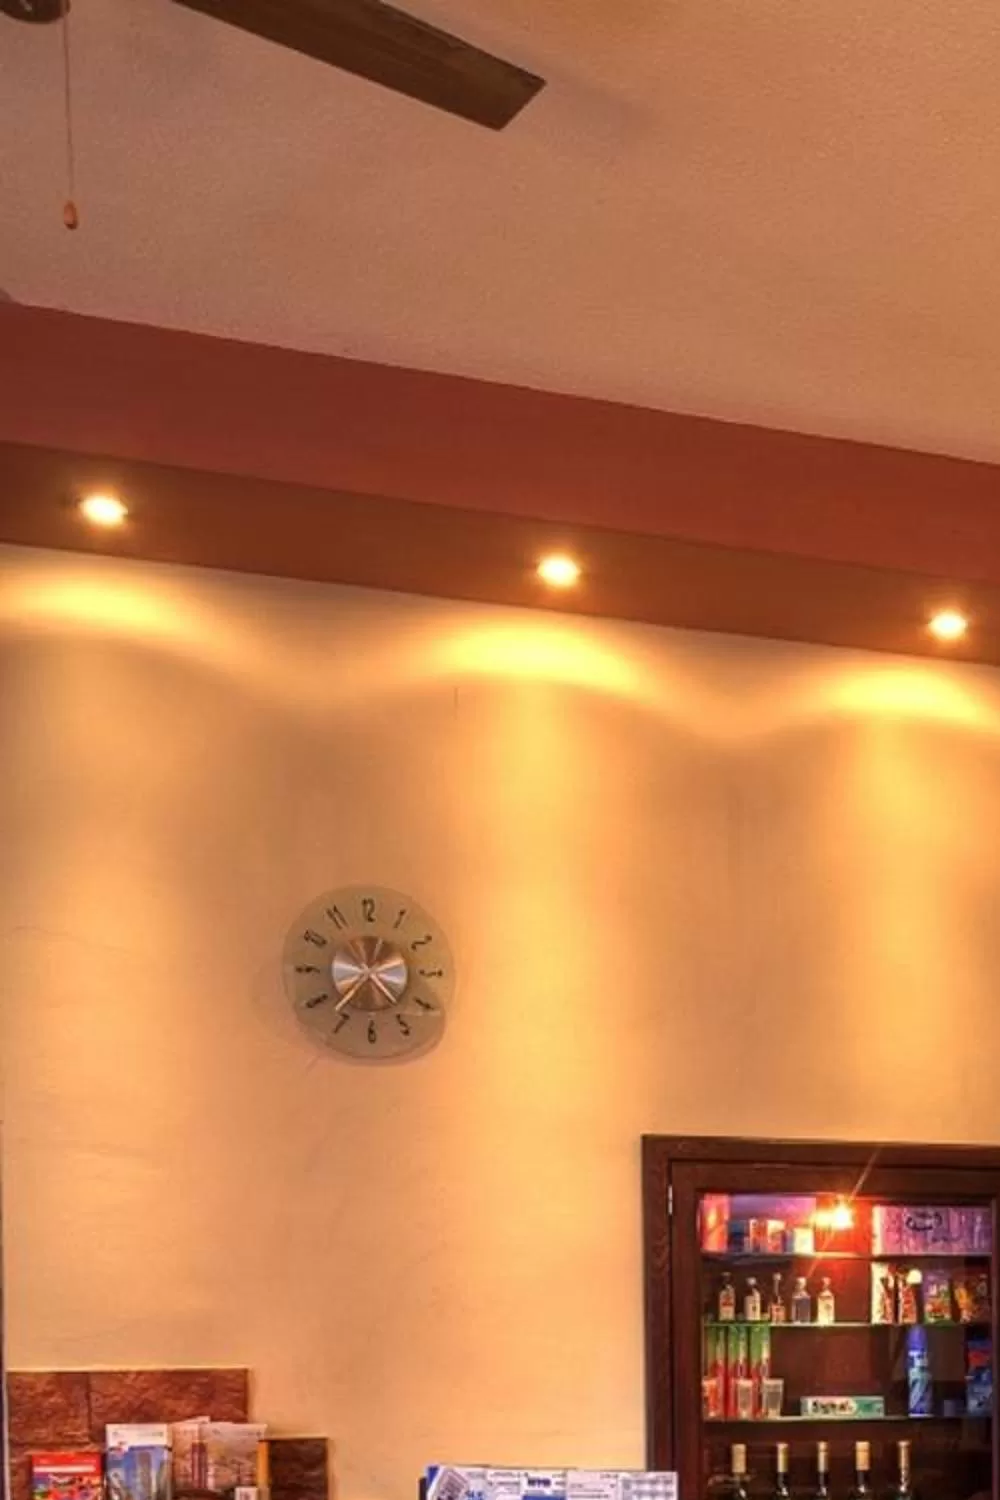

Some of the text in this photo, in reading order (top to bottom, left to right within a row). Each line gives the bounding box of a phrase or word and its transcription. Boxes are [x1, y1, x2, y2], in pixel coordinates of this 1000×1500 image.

[326, 904, 349, 930] 11
[362, 898, 376, 923] 12
[393, 908, 407, 930] 1
[411, 935, 433, 951] 2
[333, 1012, 350, 1034] 7
[366, 1019, 378, 1044] 6
